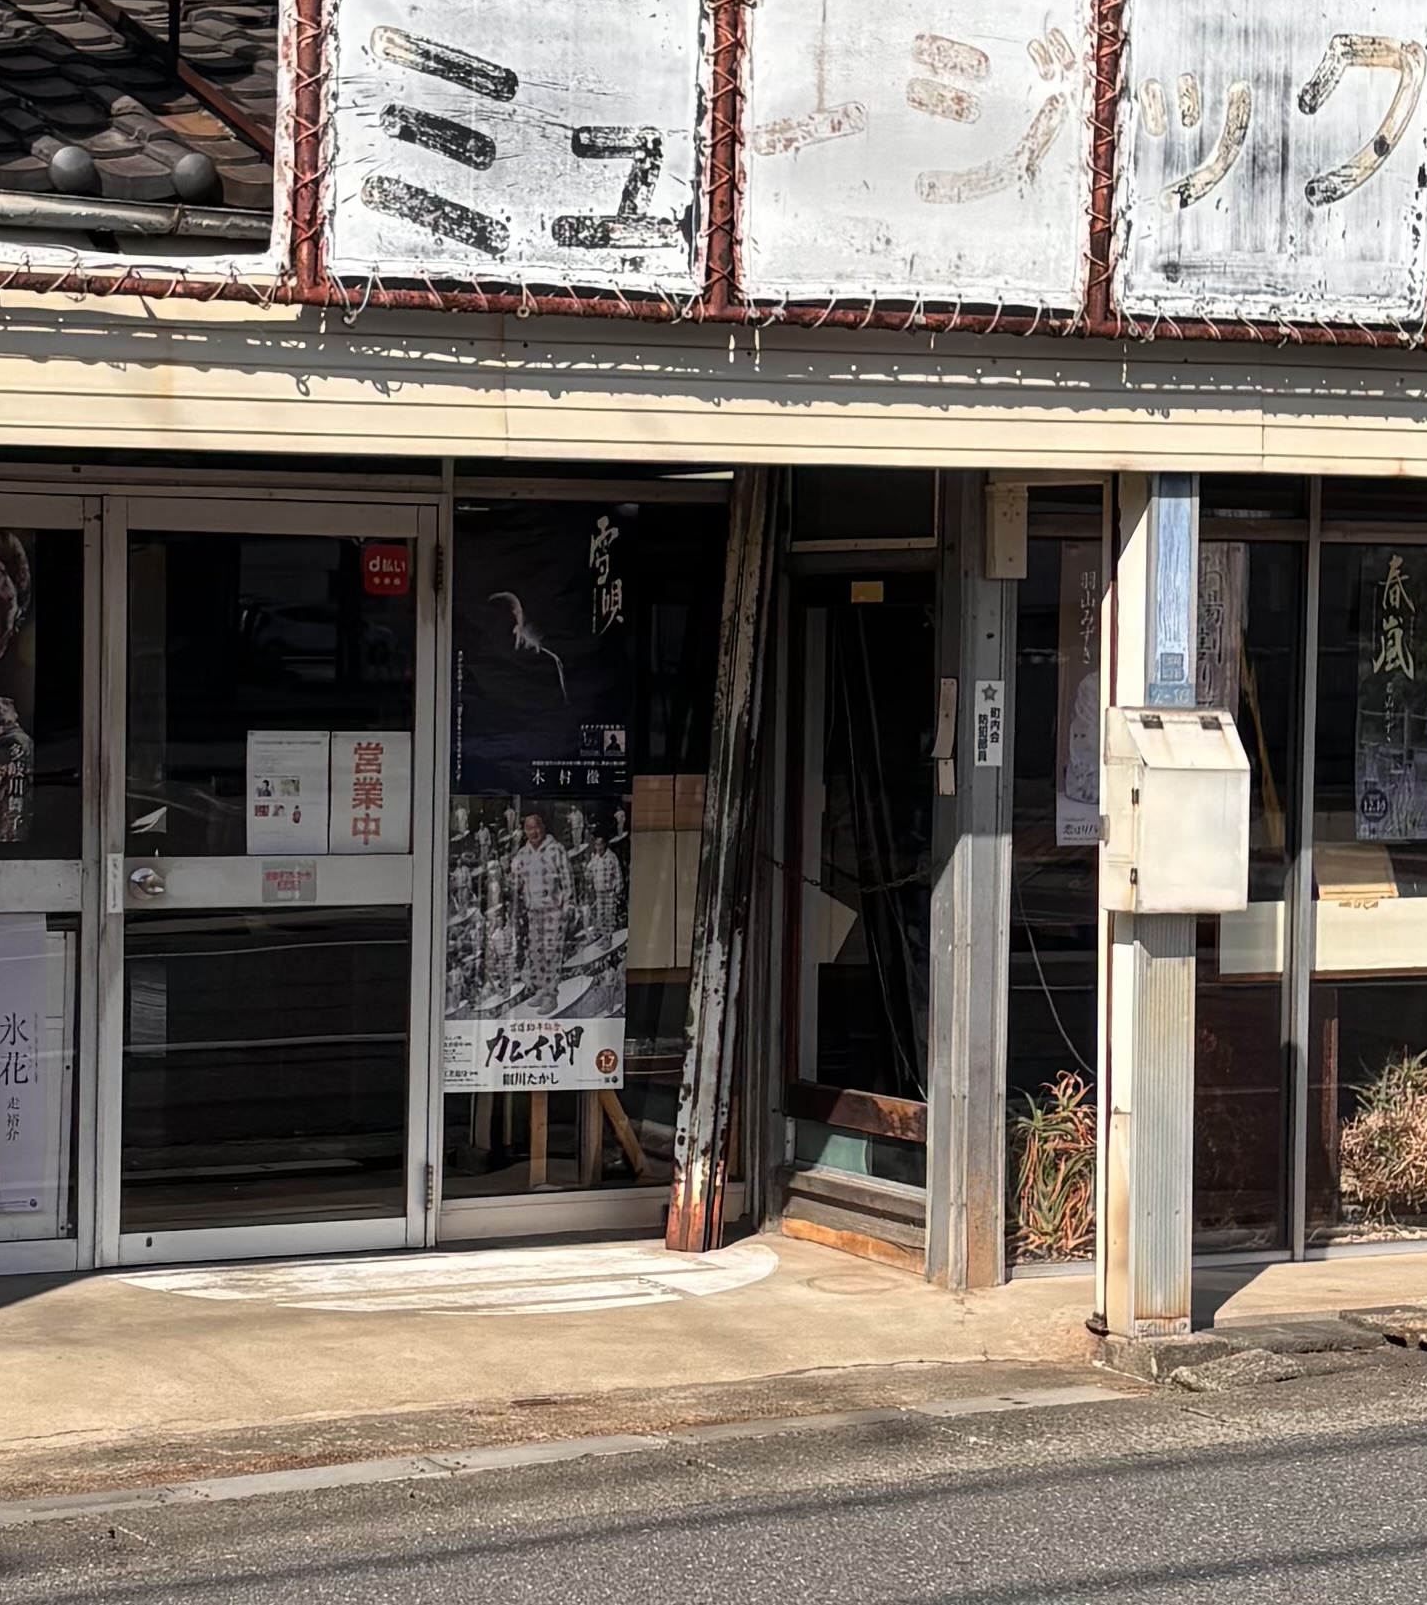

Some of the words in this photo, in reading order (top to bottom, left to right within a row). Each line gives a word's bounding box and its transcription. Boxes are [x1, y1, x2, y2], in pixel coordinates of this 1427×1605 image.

[1371, 553, 1416, 682] 春嵐
[989, 706, 1001, 744] 町内会
[351, 741, 385, 846] 営業中
[484, 1025, 586, 1068] カムイ岬
